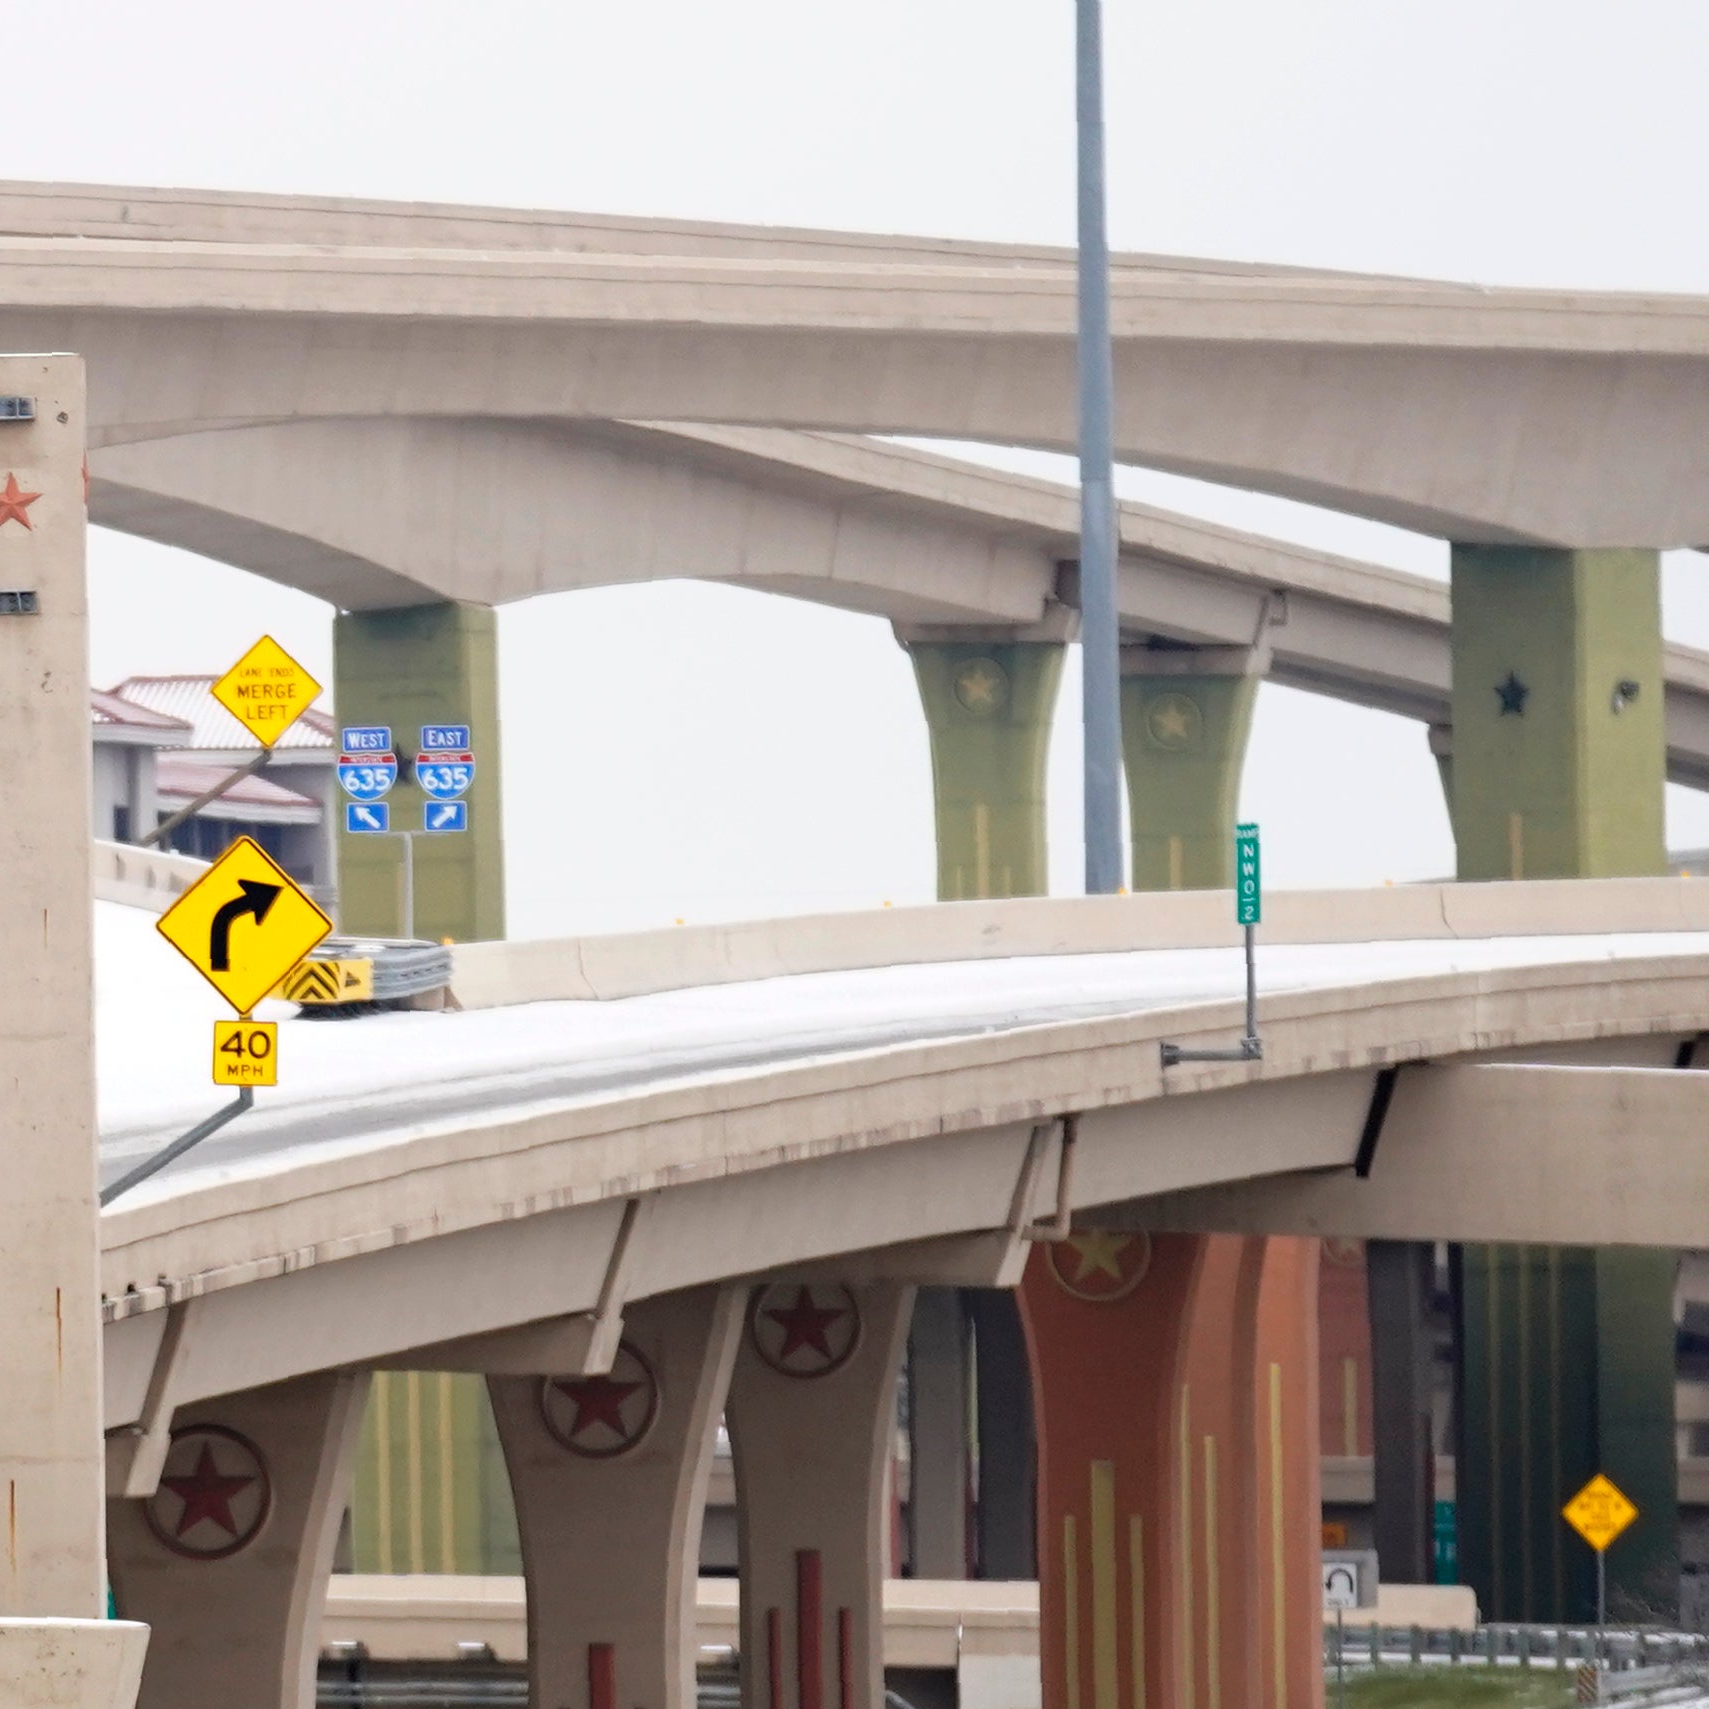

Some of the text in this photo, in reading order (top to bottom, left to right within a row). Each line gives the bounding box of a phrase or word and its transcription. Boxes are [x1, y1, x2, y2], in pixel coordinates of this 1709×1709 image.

[240, 667, 262, 677] LANE
[237, 683, 296, 699] MERGE
[246, 704, 288, 720] LEFT
[347, 732, 385, 749] WEST
[427, 730, 463, 746] EAST
[343, 768, 391, 792] 635
[422, 767, 469, 790] 635
[220, 1030, 271, 1059] 40
[227, 1064, 263, 1077] MPH
